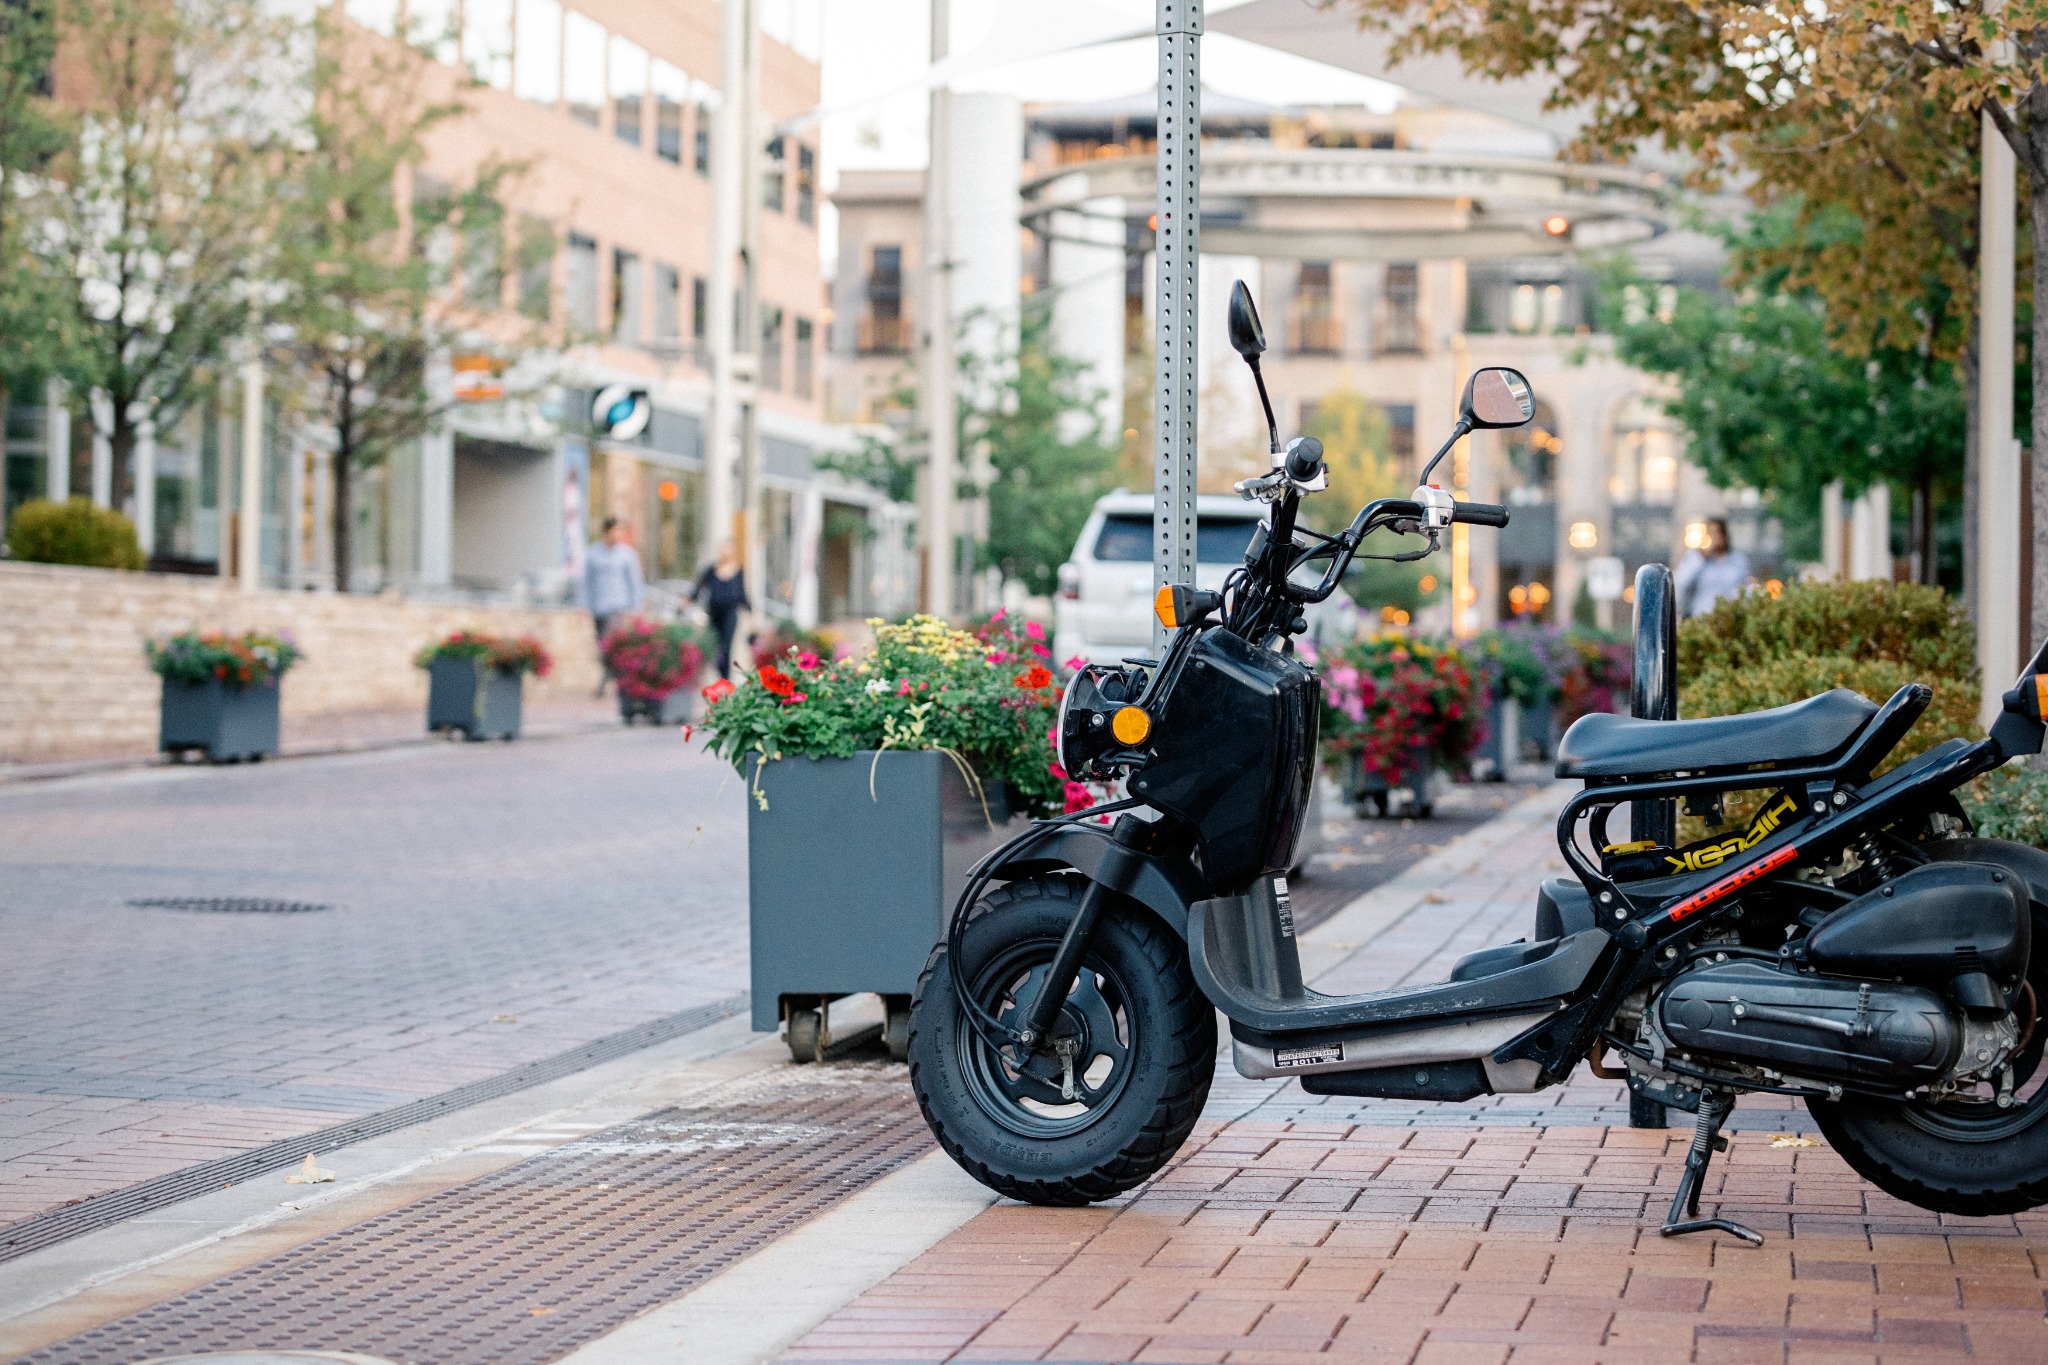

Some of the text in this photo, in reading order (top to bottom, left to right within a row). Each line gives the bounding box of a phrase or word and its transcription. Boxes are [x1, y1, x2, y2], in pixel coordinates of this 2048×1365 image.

[1664, 794, 1798, 875] HIPLOK
[1670, 845, 1797, 920] RUCKUS
[1292, 1057, 1317, 1066] 2011
